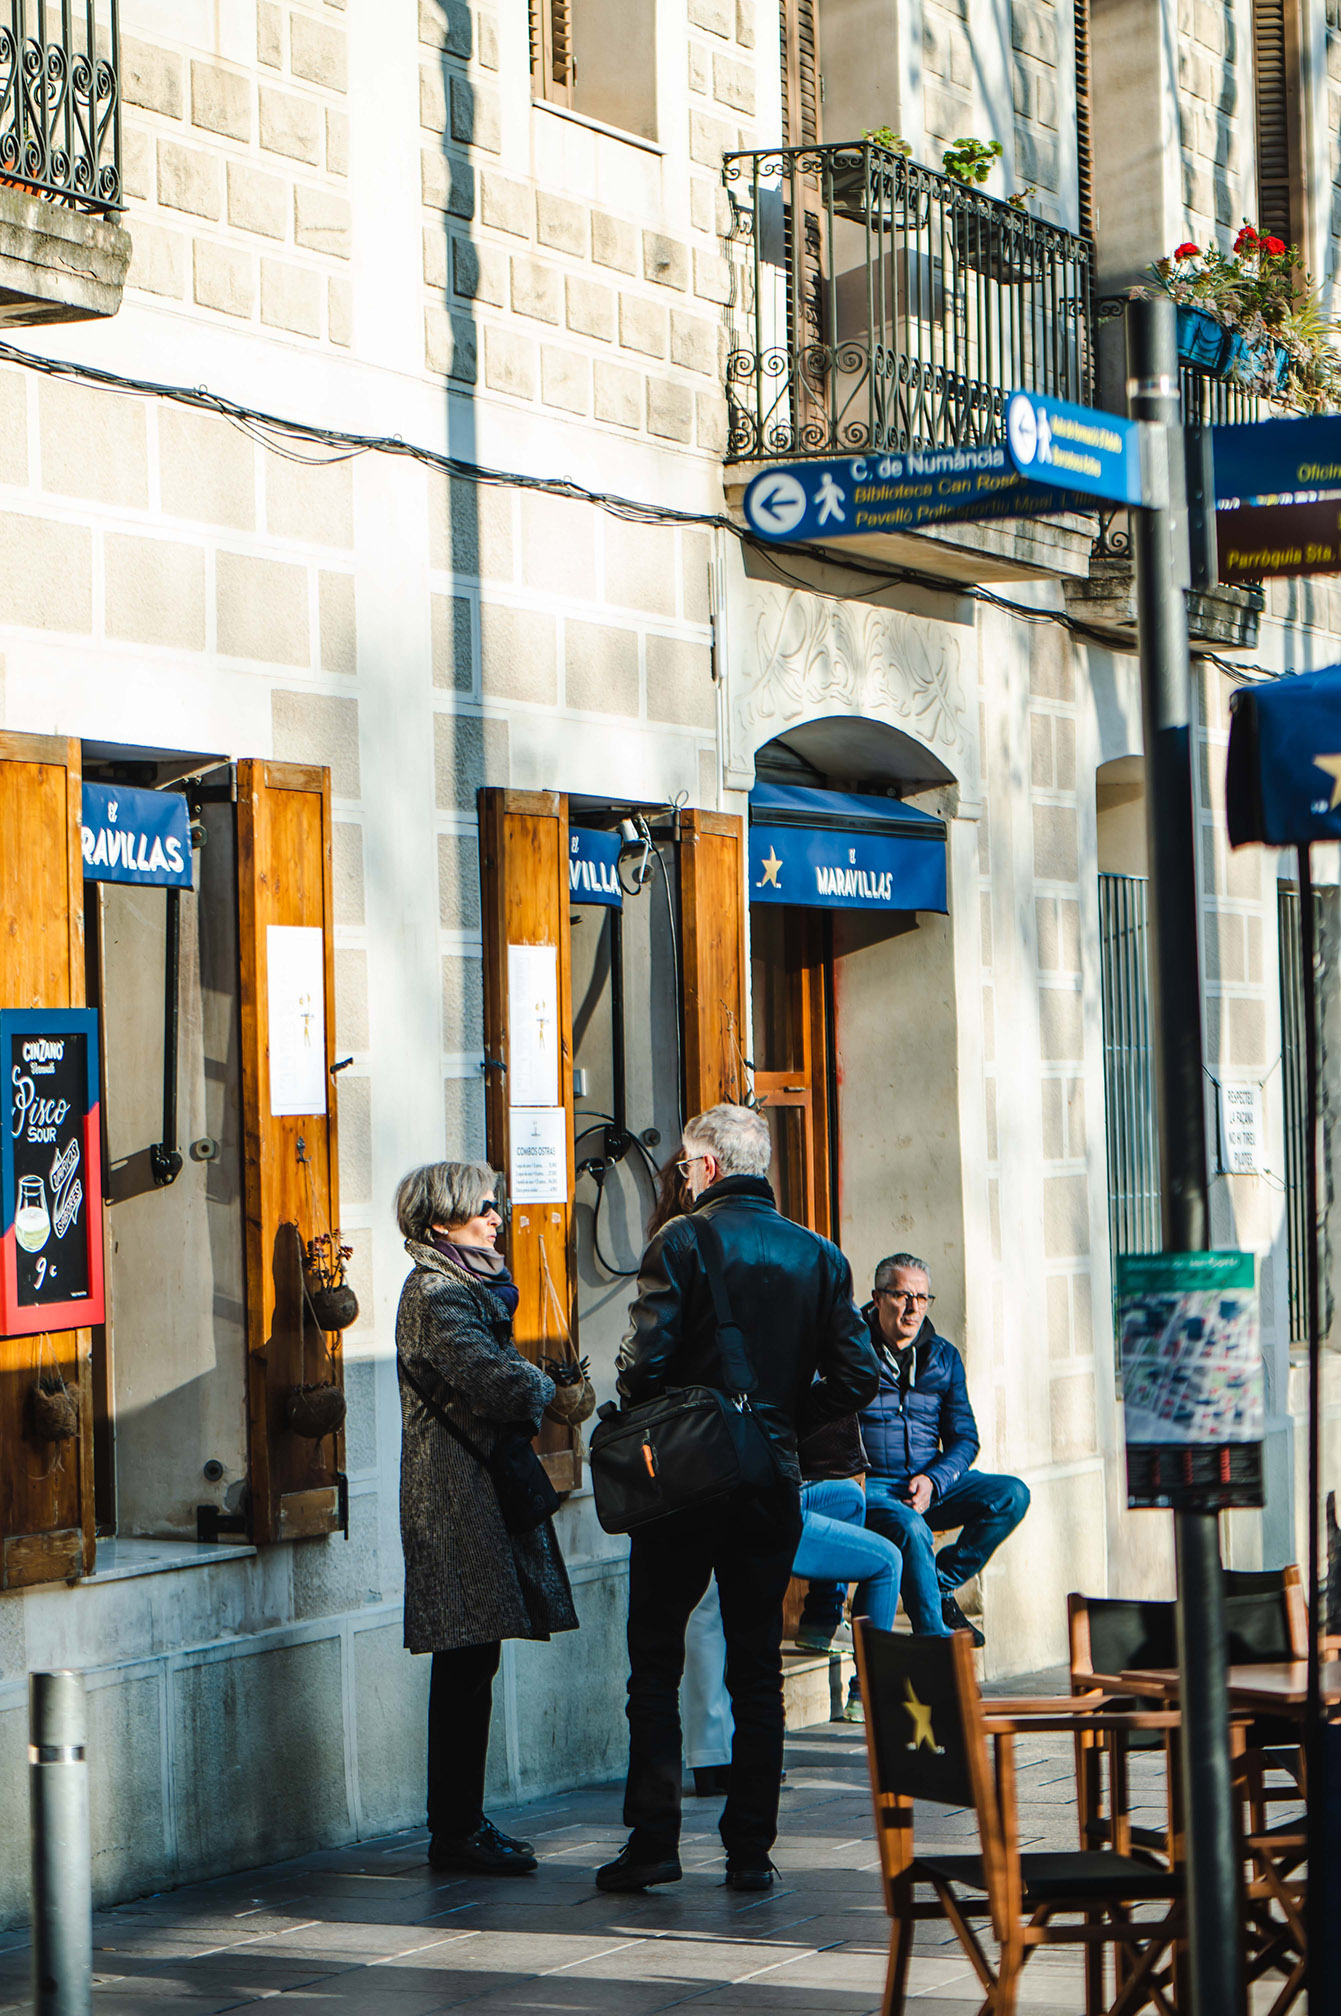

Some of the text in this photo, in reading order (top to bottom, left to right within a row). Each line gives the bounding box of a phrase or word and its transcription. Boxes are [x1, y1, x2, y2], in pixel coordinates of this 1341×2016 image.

[878, 456, 903, 479] de
[854, 482, 933, 504] Biblioteca
[938, 478, 971, 495] Can
[856, 507, 913, 528] Pavelló
[1227, 546, 1302, 570] Parròquia
[815, 865, 894, 901] MARAVILLAS
[22, 1038, 65, 1063] CINZANO
[11, 1064, 71, 1138] Pisco
[27, 1126, 57, 1143] SOUR
